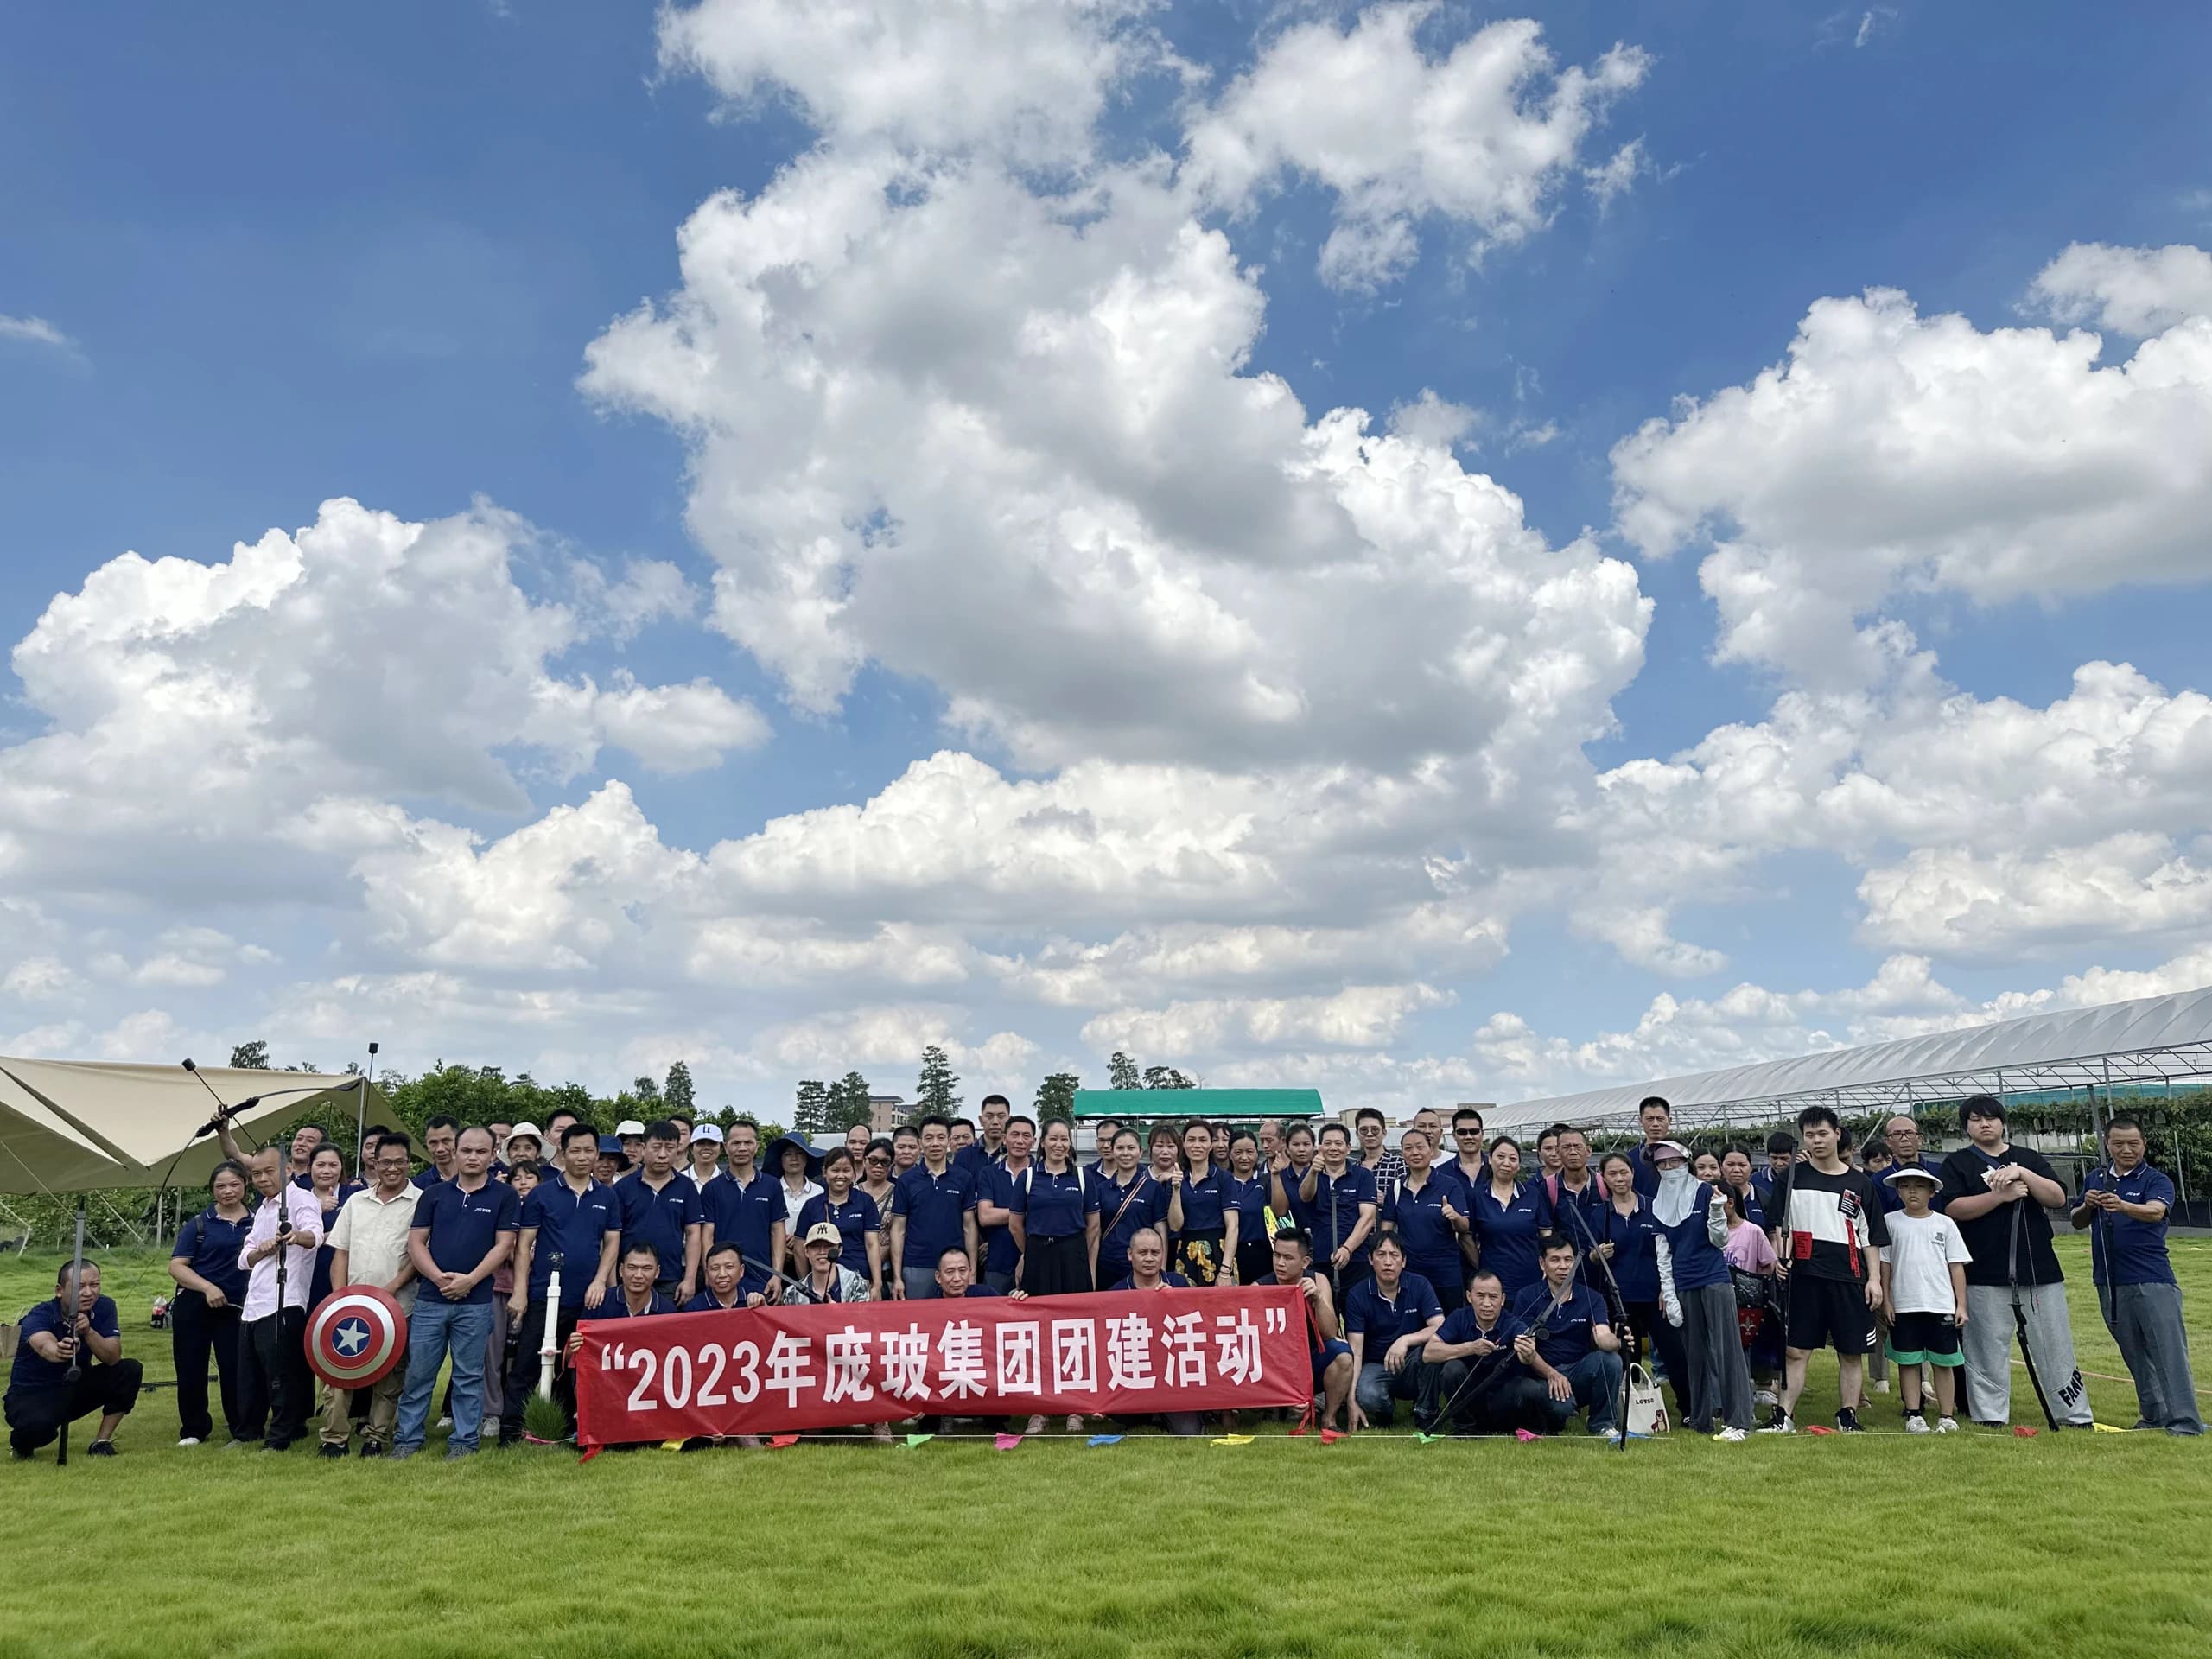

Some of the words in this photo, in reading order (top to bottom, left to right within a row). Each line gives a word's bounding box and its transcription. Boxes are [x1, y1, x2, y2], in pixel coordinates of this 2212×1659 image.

[602, 1307, 1287, 1411] “2023年庞玻集团团建活动”
